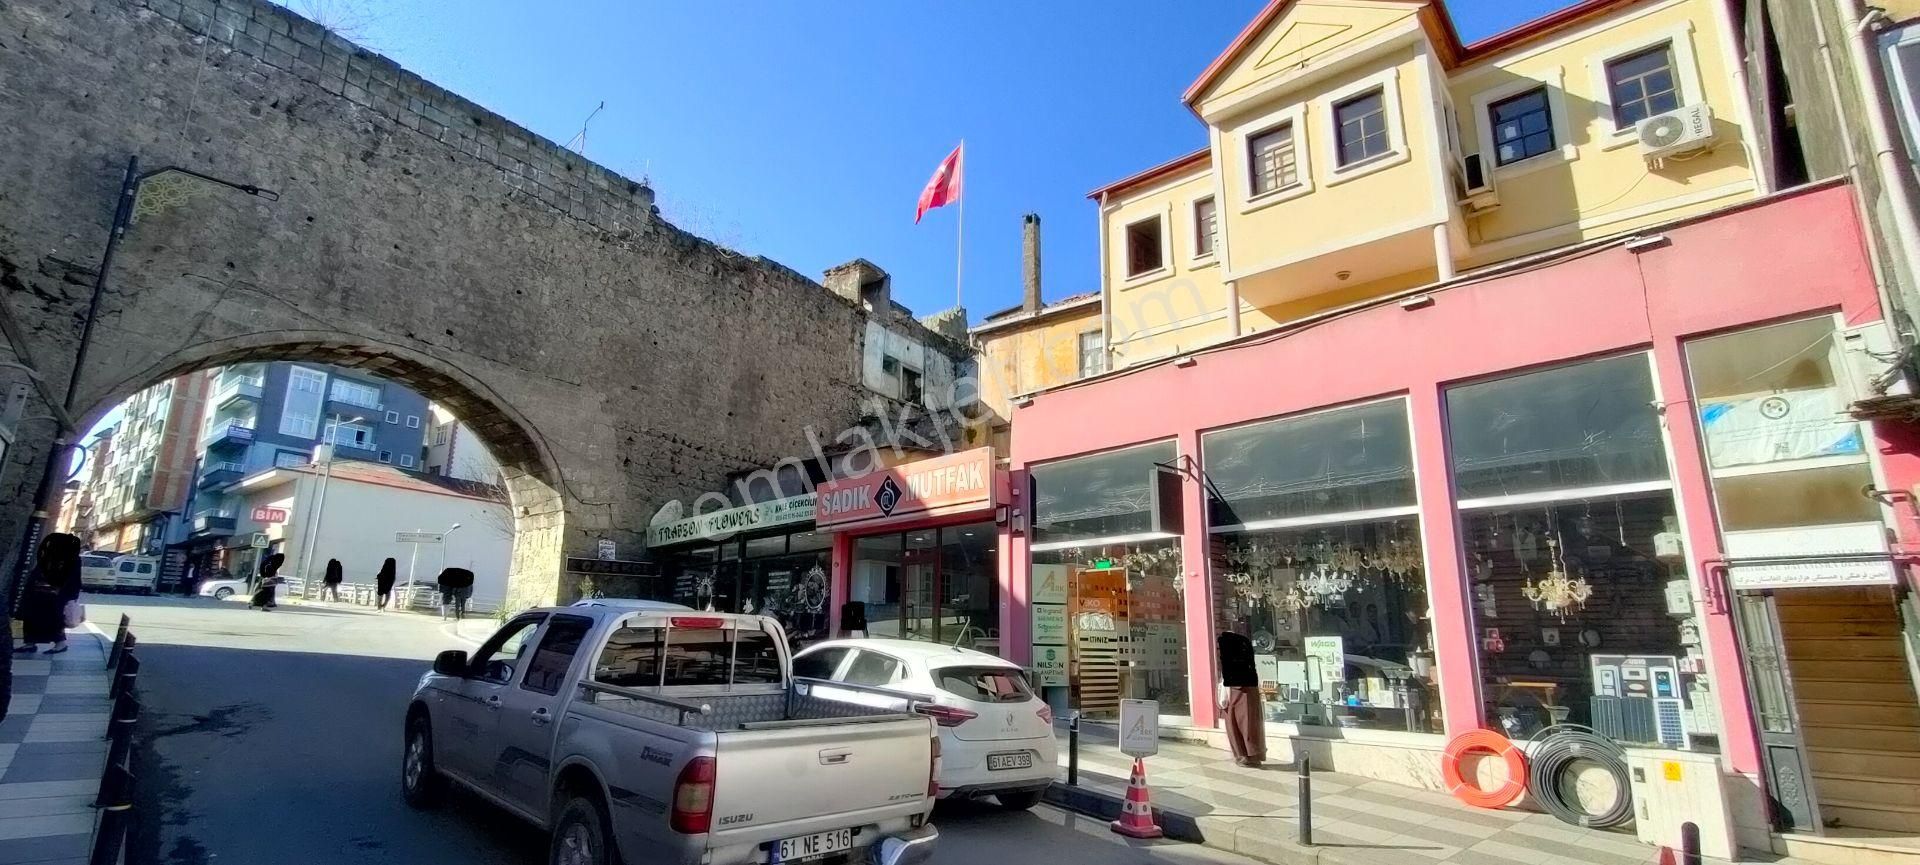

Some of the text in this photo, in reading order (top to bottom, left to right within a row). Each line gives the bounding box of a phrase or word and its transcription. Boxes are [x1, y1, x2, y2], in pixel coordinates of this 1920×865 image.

[1691, 108, 1704, 134] REGAL
[821, 484, 871, 515] SADIK
[905, 459, 985, 501] MUTFAK
[708, 508, 760, 533] FLOWERS
[1037, 661, 1064, 669] NILSON
[718, 812, 754, 825] ISUZU
[781, 839, 796, 858] 61
[803, 835, 819, 854] NE
[826, 830, 849, 850] 516
